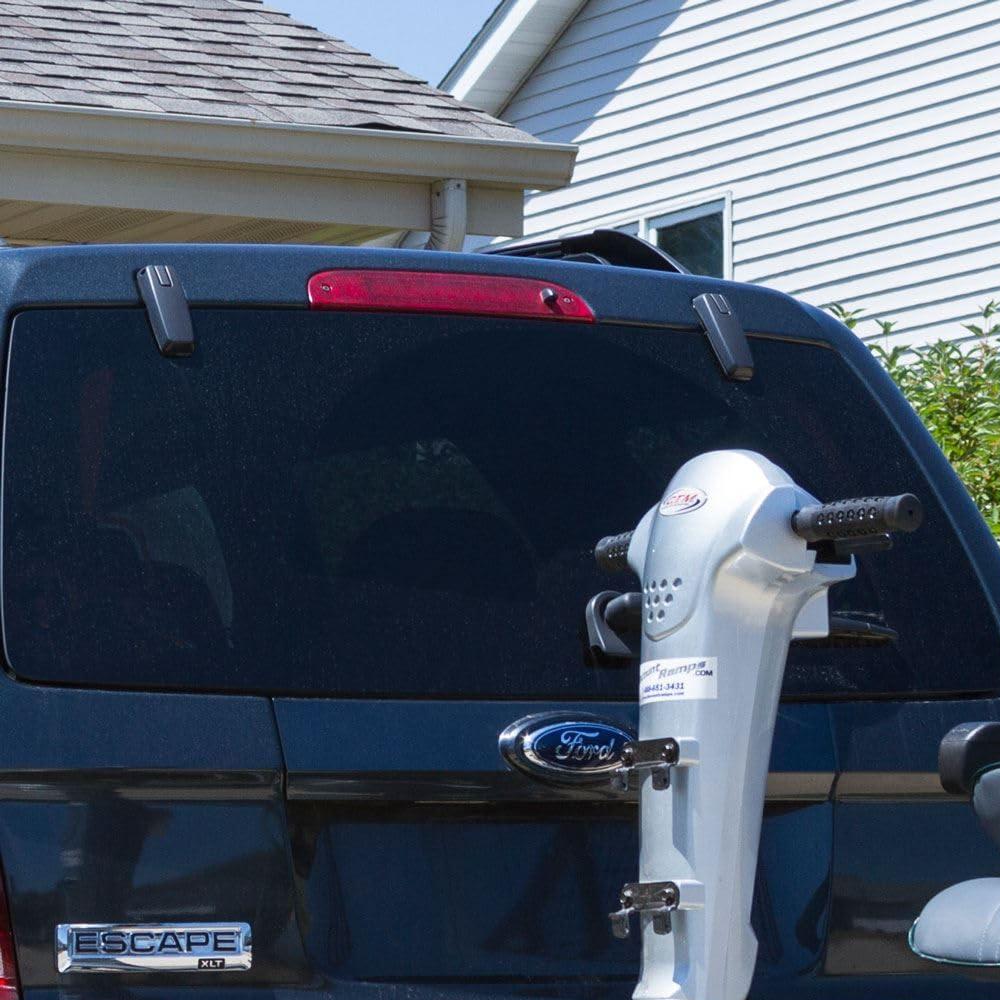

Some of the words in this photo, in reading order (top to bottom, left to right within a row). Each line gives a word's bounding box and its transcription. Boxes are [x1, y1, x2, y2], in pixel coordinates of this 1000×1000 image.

[555, 730, 615, 760] Ford
[74, 931, 238, 953] ESCAPE
[201, 959, 223, 968] XLT
